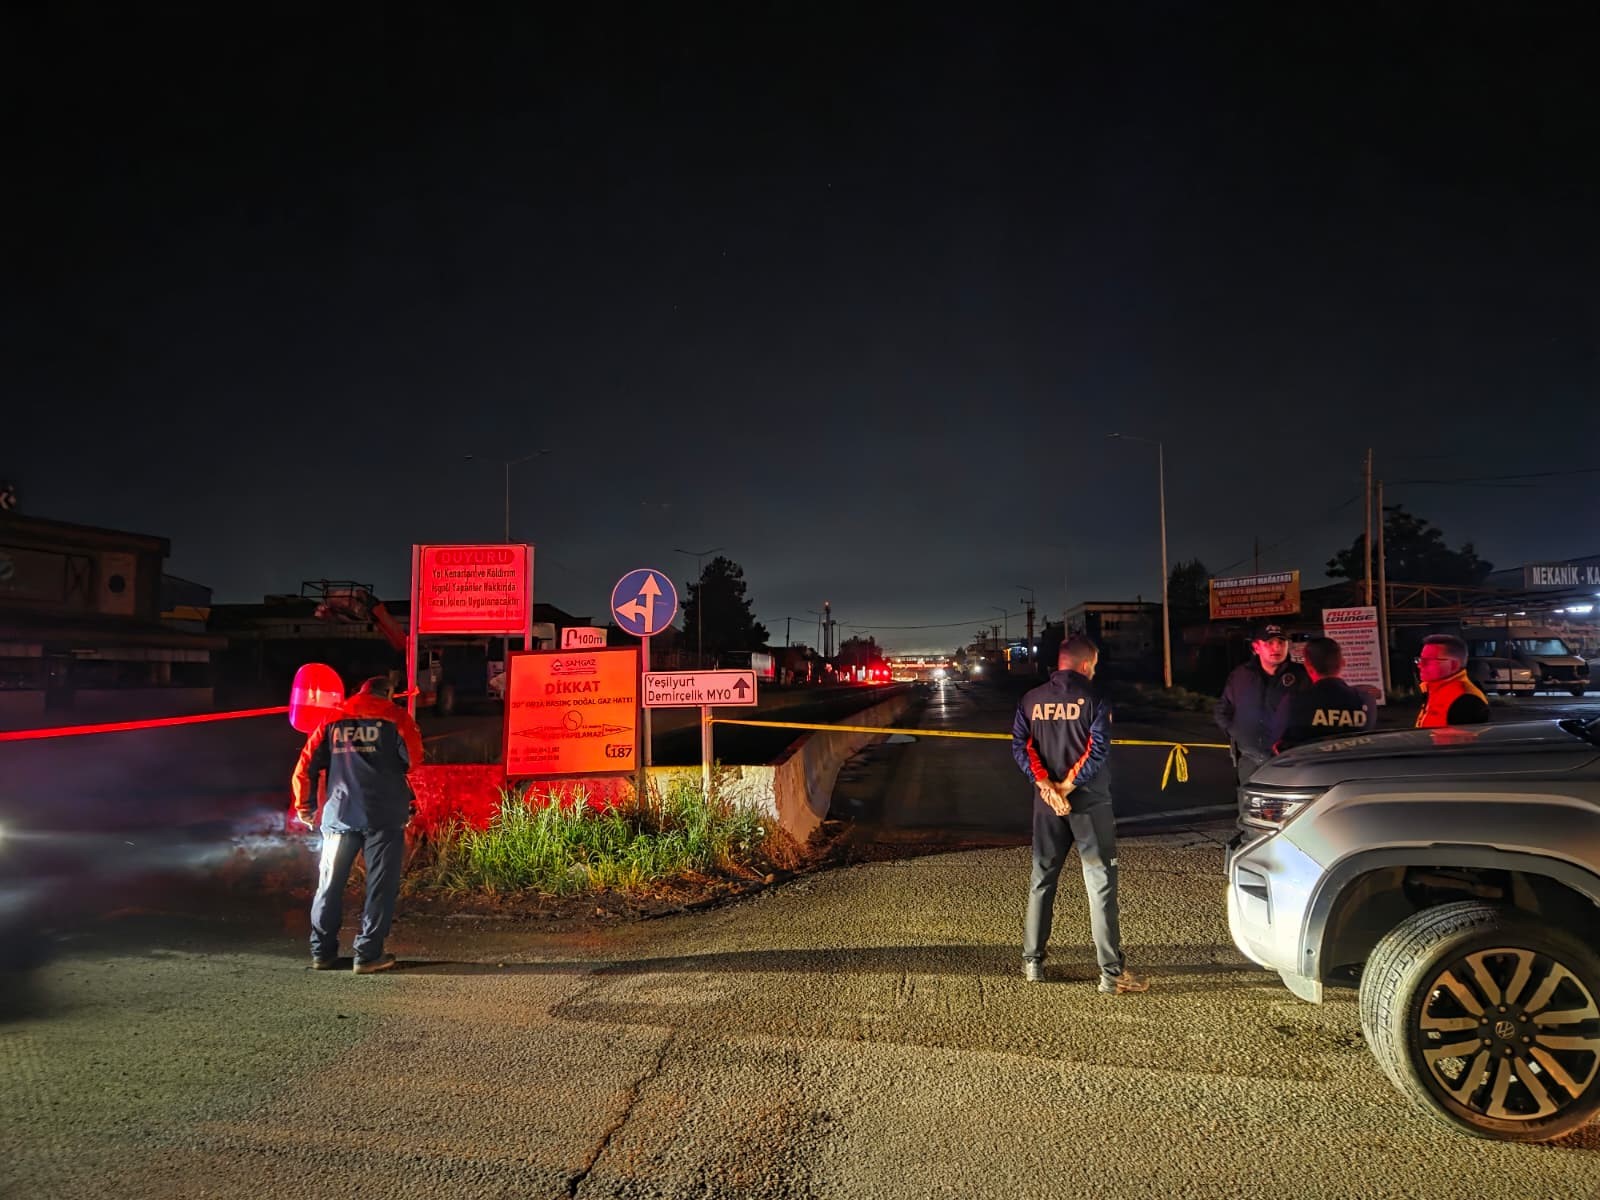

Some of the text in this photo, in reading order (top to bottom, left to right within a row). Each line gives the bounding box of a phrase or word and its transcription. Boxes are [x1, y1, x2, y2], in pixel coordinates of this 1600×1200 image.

[441, 551, 507, 563] DUYURU
[1532, 564, 1579, 585] MEKANİK
[1326, 614, 1375, 623] LOUNGE
[578, 634, 603, 645] 100m
[545, 680, 601, 695] DİKKAT
[647, 676, 695, 689] Yeşilyurt
[648, 688, 731, 702] Demirçelik MYO
[1031, 703, 1081, 721] AFAD
[1311, 708, 1367, 727] AFAD
[332, 726, 379, 743] AFAD
[611, 747, 633, 758] 187
